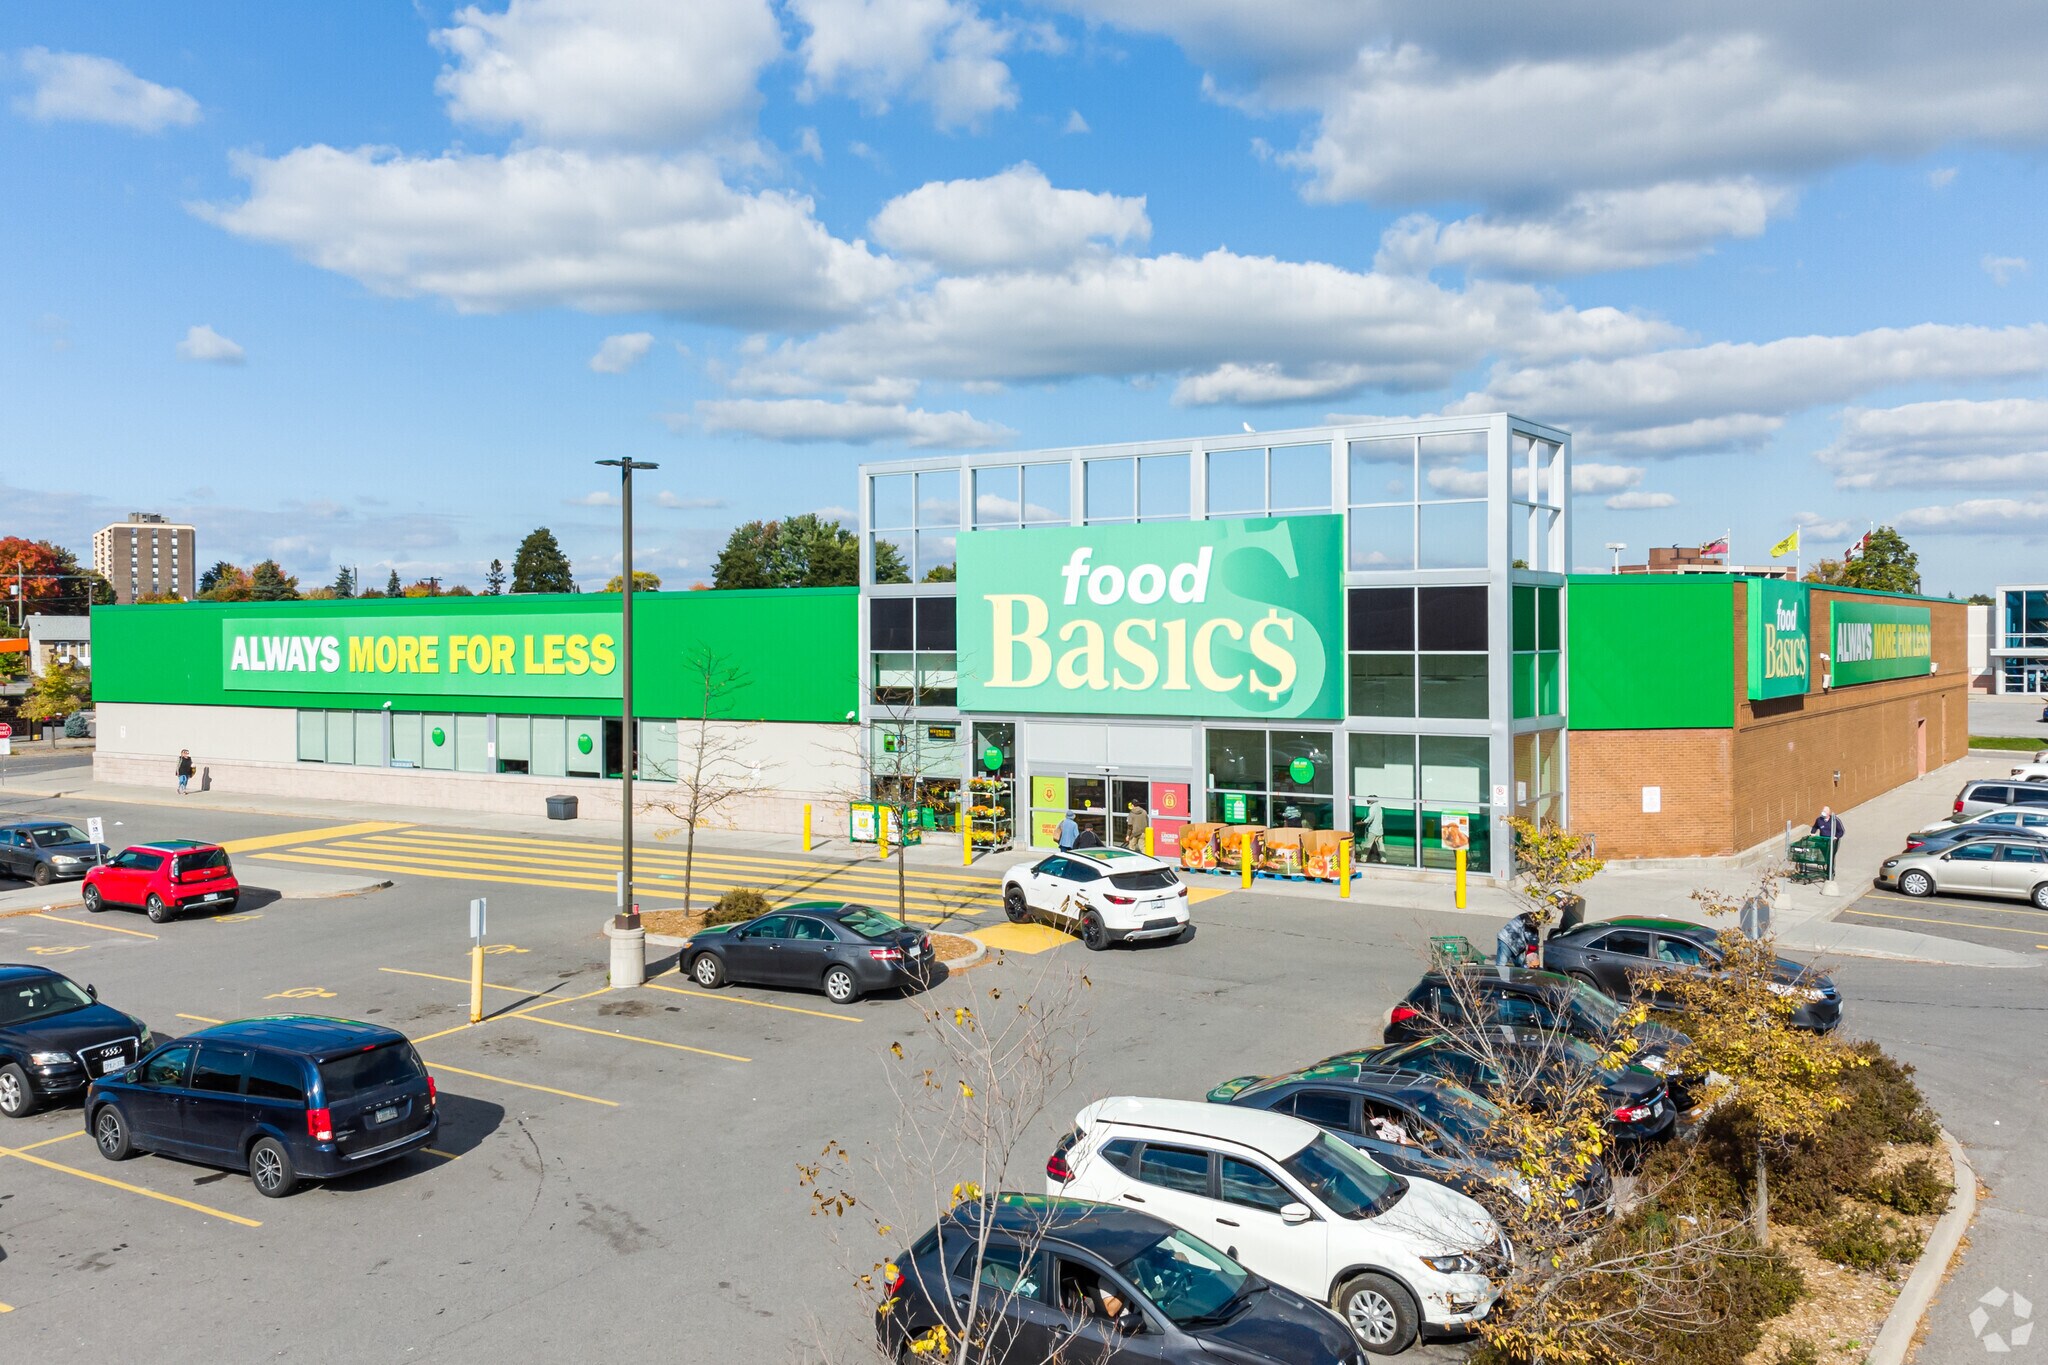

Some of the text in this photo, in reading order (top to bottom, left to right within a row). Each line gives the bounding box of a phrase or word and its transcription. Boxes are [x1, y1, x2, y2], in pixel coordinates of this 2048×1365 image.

[1061, 545, 1213, 605] food
[1776, 599, 1797, 631] food
[230, 633, 616, 676] ALWAYS MORE FOR LESS
[1836, 622, 1929, 663] ALWAYS MORE FOR LESS
